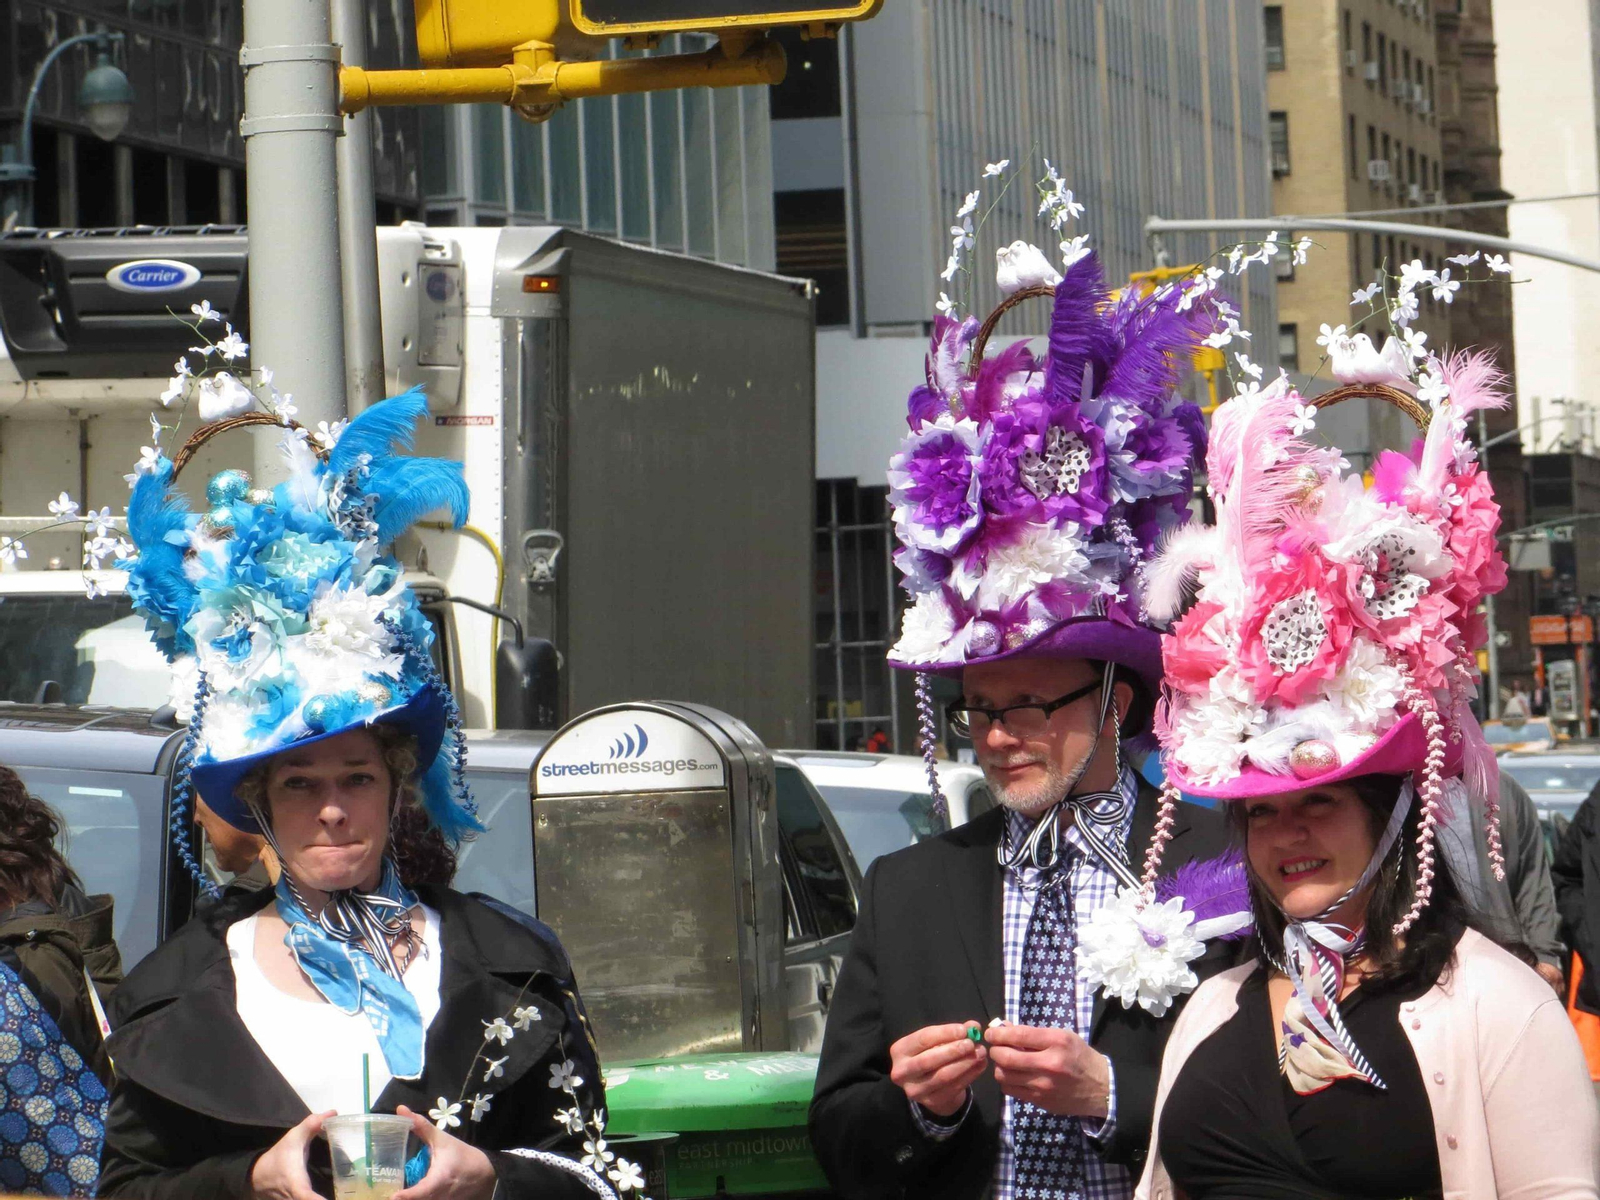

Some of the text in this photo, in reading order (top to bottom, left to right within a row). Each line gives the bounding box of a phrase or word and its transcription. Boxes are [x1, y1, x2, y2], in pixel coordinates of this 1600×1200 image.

[128, 269, 179, 282] Carrier
[541, 757, 718, 778] streetmessages.com
[704, 1069, 730, 1082] &
[677, 1140, 721, 1159] east
